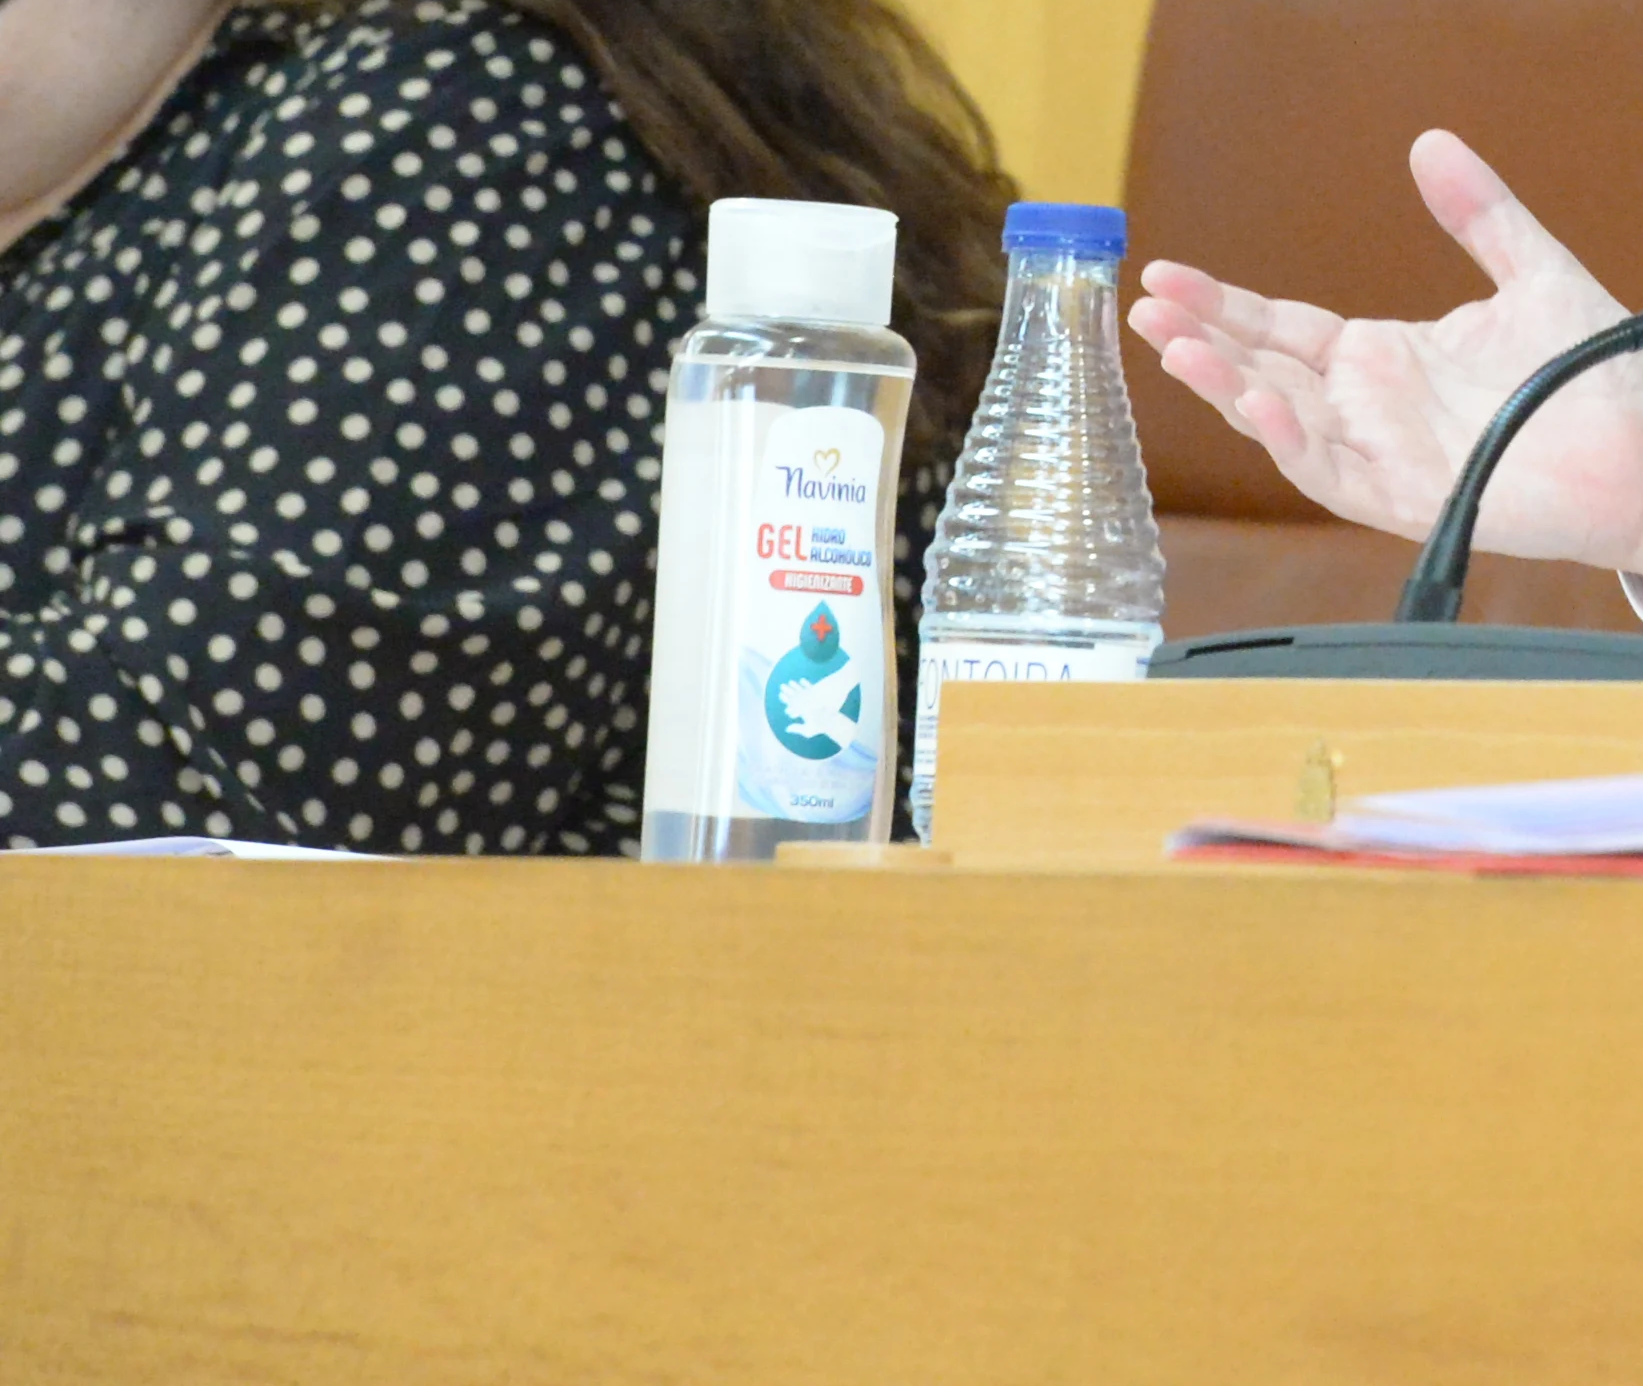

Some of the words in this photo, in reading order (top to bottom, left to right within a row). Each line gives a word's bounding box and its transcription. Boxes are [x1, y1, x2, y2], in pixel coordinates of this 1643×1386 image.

[776, 466, 866, 503] Navinia
[757, 523, 807, 561] GEL
[811, 527, 846, 545] HIDRO
[790, 794, 834, 808] 350ml
